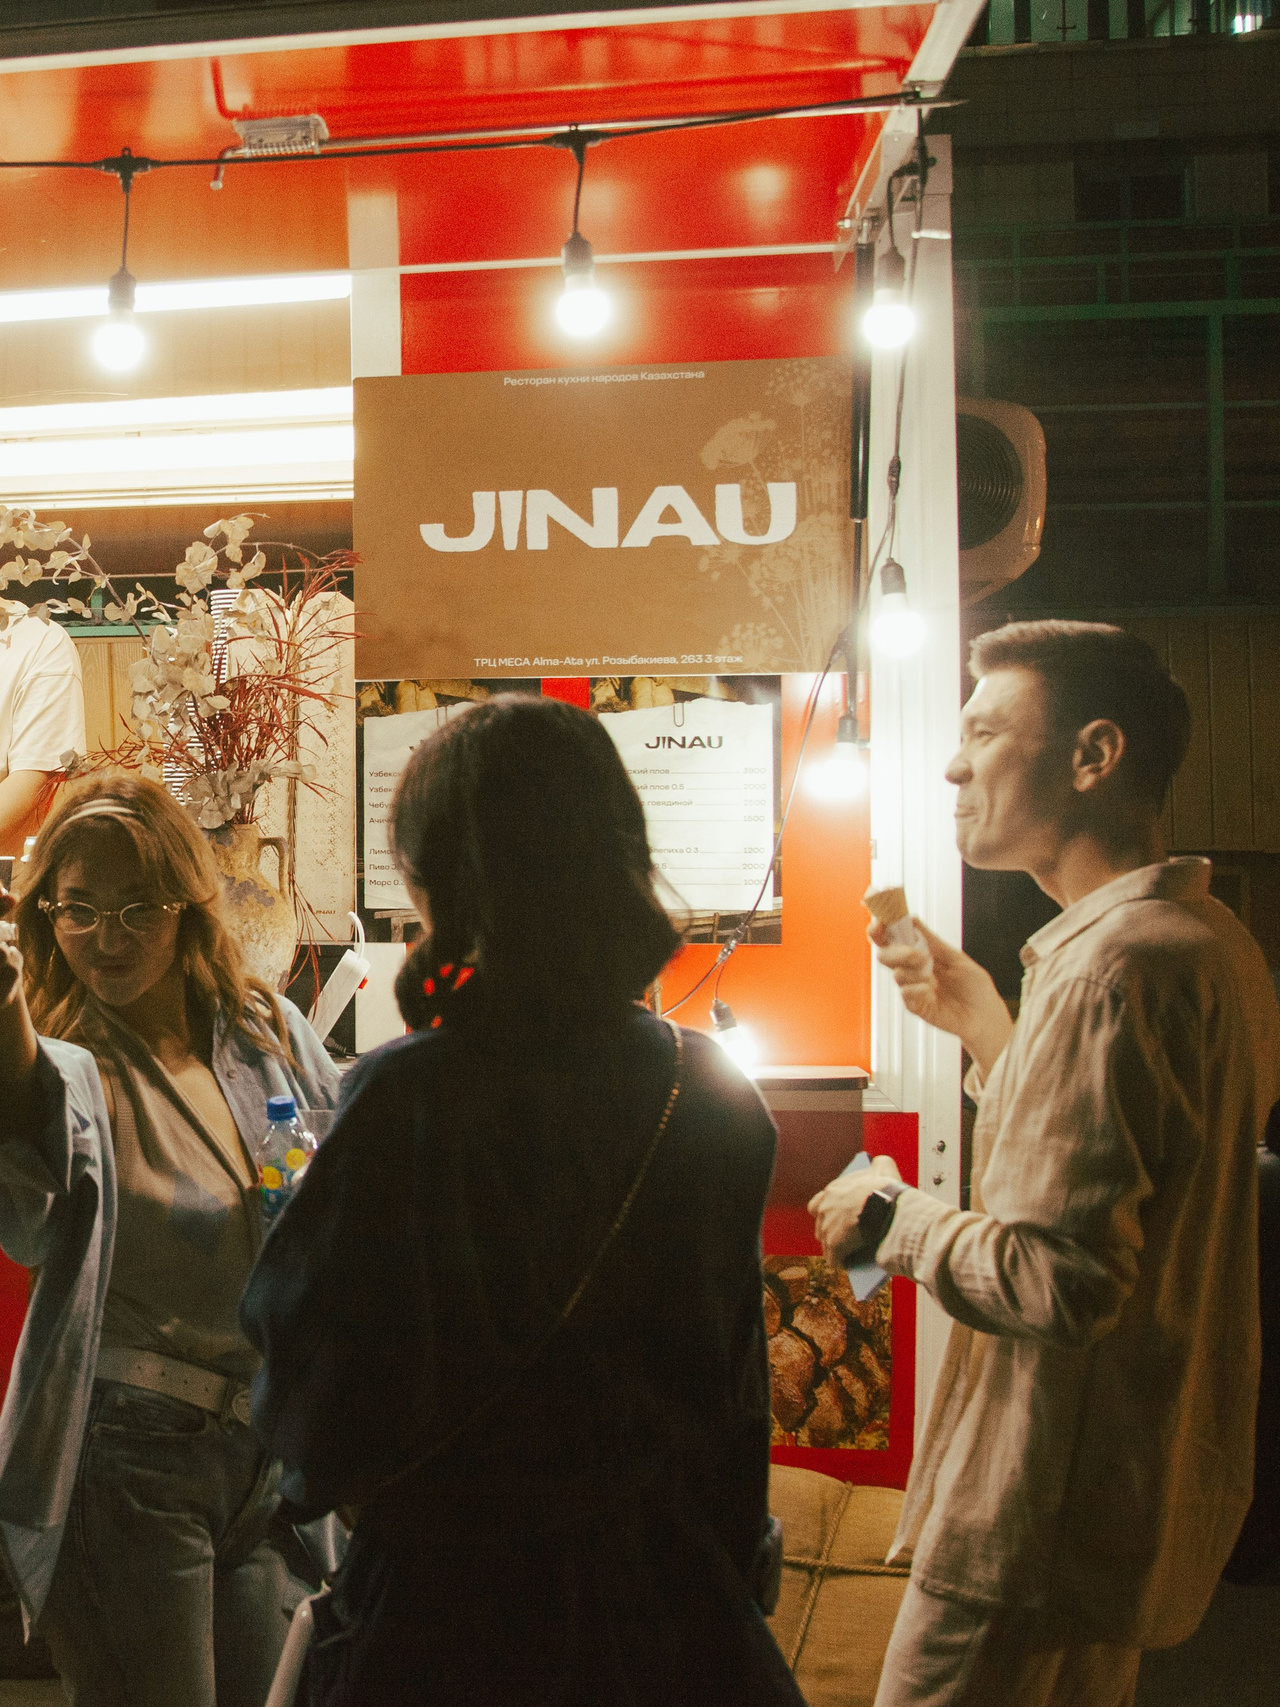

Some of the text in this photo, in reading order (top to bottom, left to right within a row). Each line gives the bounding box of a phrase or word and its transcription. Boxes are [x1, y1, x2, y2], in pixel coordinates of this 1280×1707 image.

[504, 370, 705, 387] Ресторан кухни народов Казахстана
[420, 482, 797, 552] JINAU
[474, 658, 496, 668] ТРЦ
[532, 656, 583, 666] Alma-Ata
[585, 658, 600, 668] ул.
[681, 655, 703, 664] 263
[705, 654, 712, 664] 3
[714, 655, 743, 664] этаж
[644, 735, 723, 749] JINAU
[647, 799, 693, 807] говядиной
[369, 879, 392, 887] Морс
